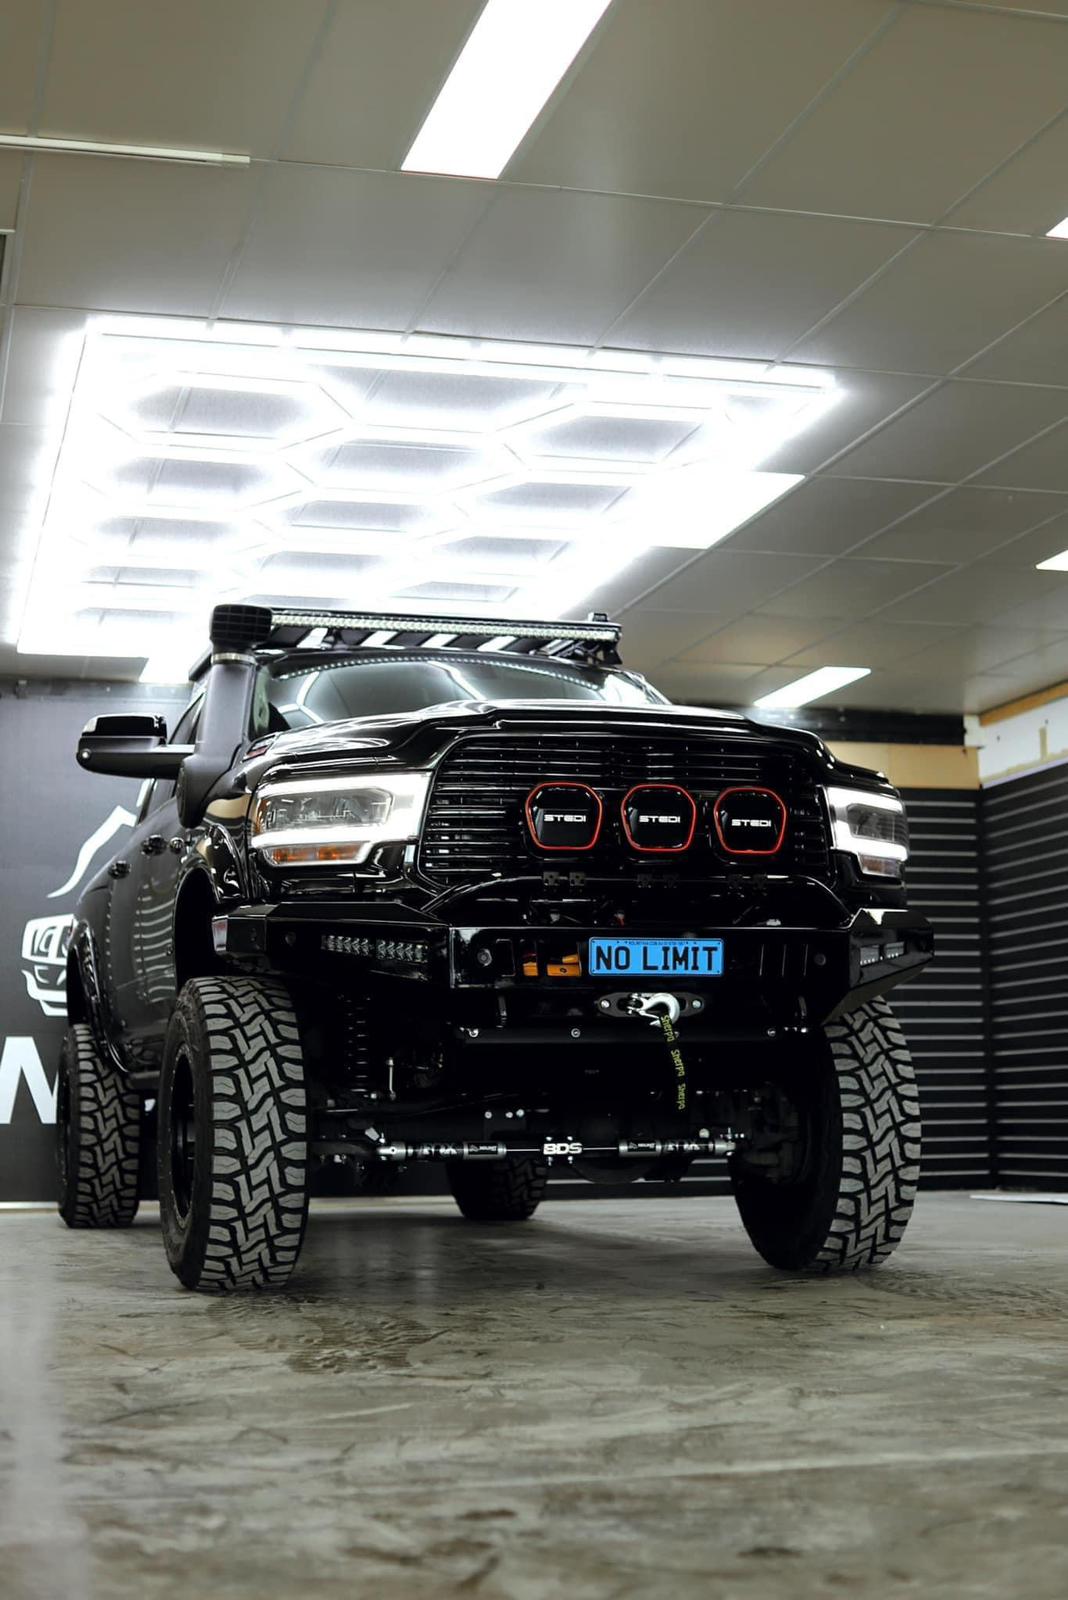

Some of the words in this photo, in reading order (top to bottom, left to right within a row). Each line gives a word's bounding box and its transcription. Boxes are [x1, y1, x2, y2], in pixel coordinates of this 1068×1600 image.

[543, 814, 587, 823] STEDI
[639, 815, 681, 823] STEDI
[731, 819, 772, 827] STEDI
[595, 945, 631, 971] NO
[642, 945, 719, 971] LIMIT
[543, 1142, 583, 1155] BDS
